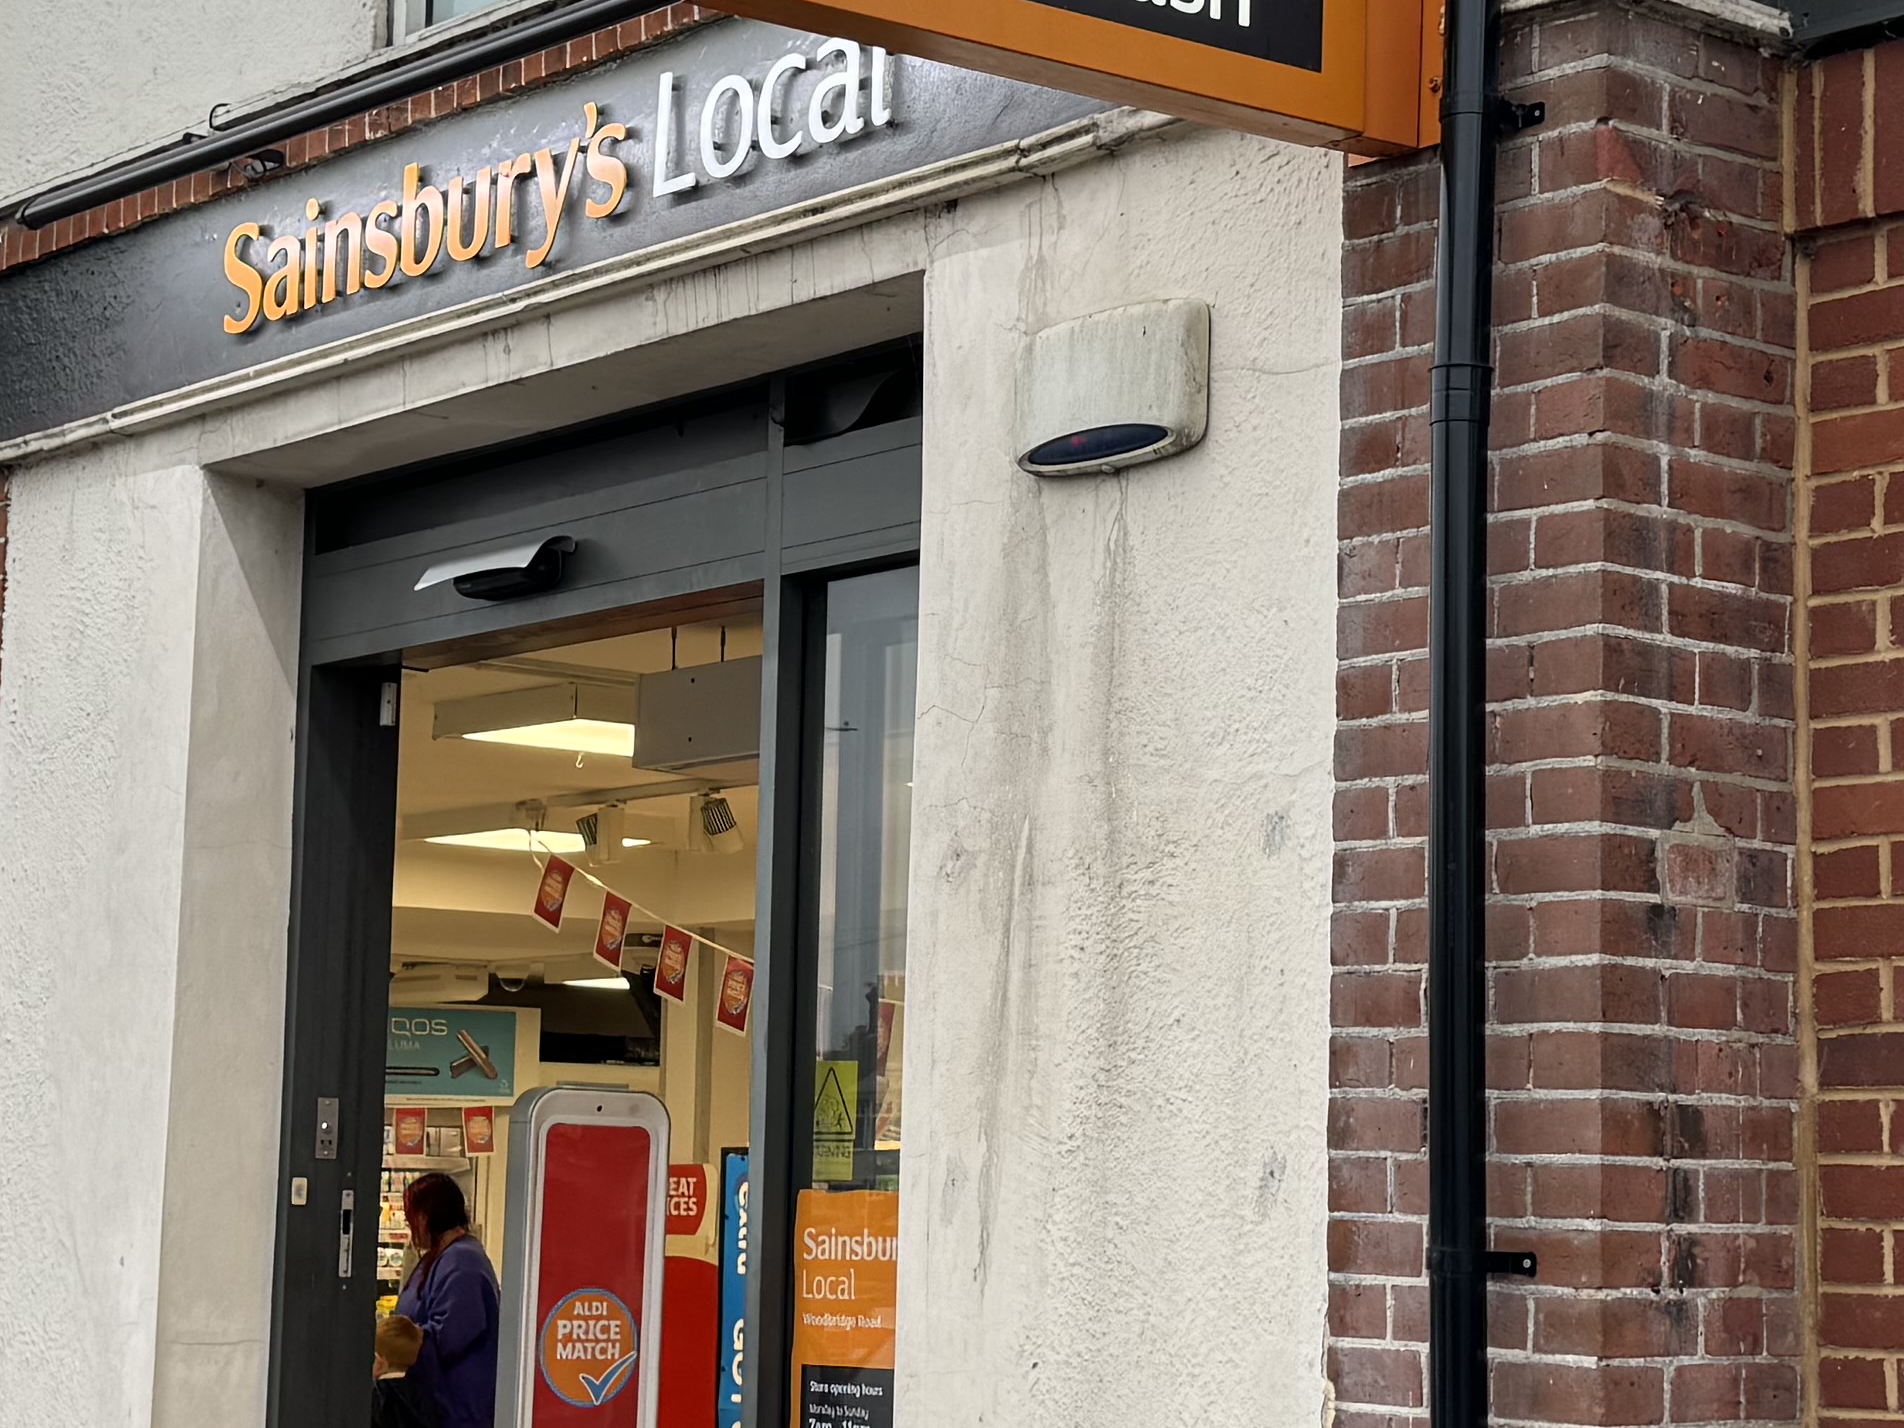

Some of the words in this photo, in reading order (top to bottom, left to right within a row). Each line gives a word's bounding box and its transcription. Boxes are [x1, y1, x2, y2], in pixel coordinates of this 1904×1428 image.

[224, 102, 628, 334] Sainsbury's
[652, 37, 890, 198] Local
[802, 1268, 855, 1300] Local
[573, 1301, 608, 1316] ALDI
[557, 1320, 621, 1340] PRICE
[858, 1315, 881, 1328] Road
[557, 1342, 620, 1360] MATCH
[862, 1384, 883, 1396] hours
